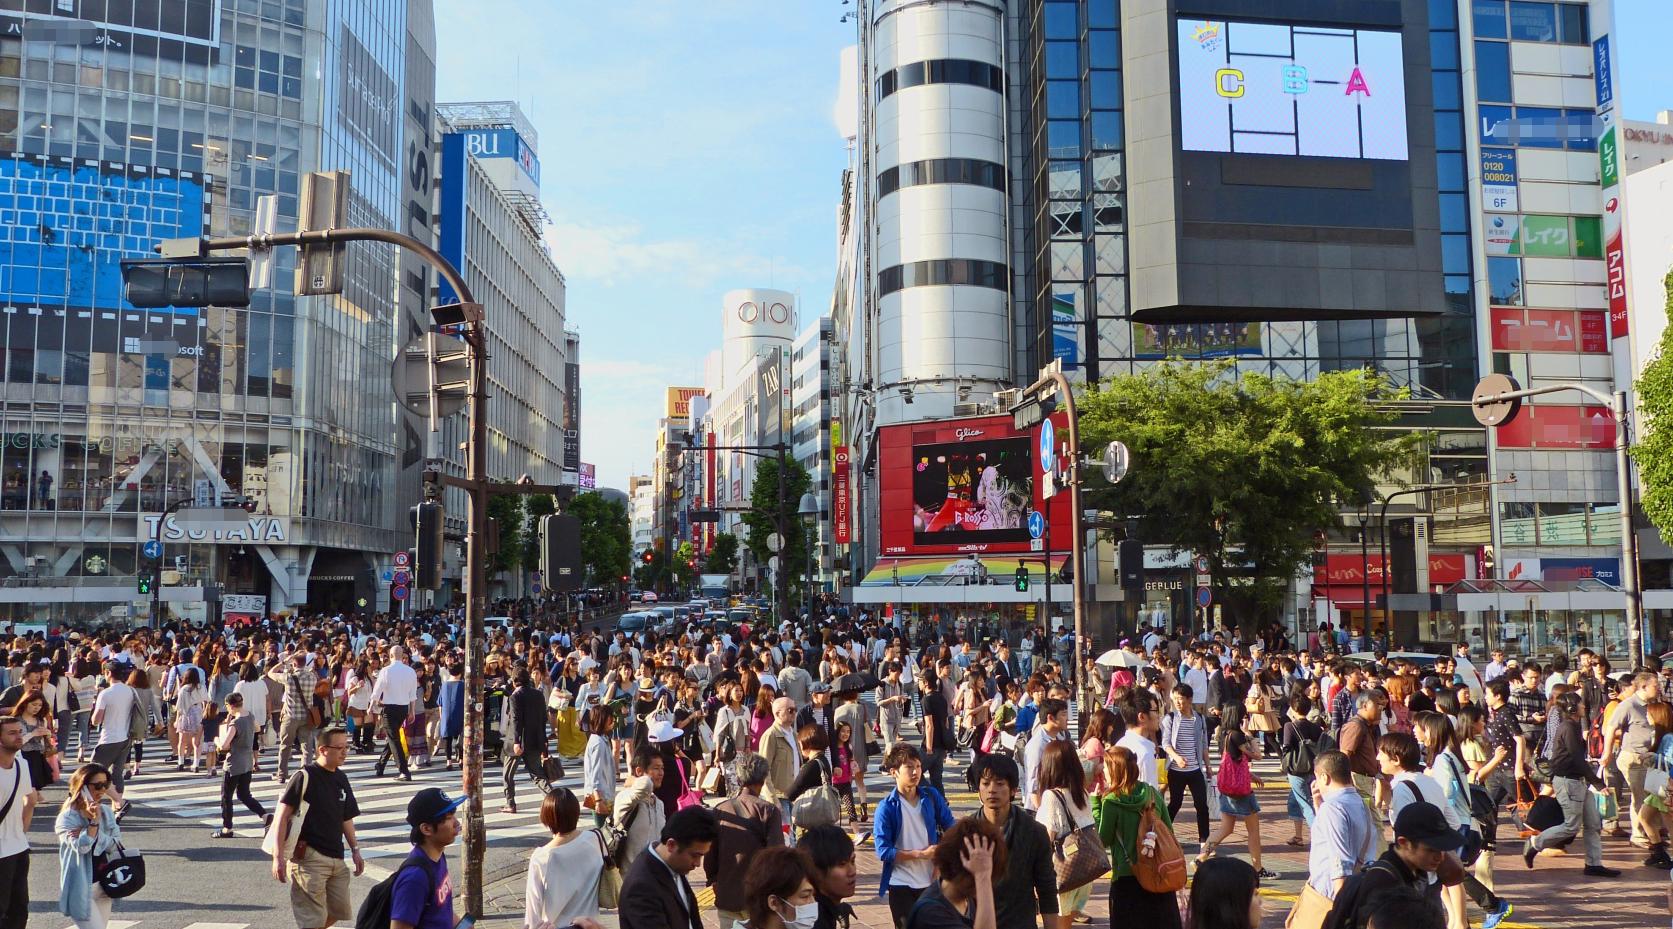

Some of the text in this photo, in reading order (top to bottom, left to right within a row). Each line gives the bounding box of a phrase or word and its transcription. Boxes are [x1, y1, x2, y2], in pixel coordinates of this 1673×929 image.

[1215, 65, 1371, 97] C B A
[1623, 127, 1660, 145] OKYU
[1483, 162, 1504, 170] 0120
[1604, 143, 1614, 177] レイク
[1493, 198, 1507, 208] 6F
[1523, 226, 1568, 245] レイク
[402, 97, 431, 471] TSUTA
[1608, 249, 1624, 299] アコム
[762, 363, 779, 397] ZAR
[144, 515, 285, 541] TSYA
